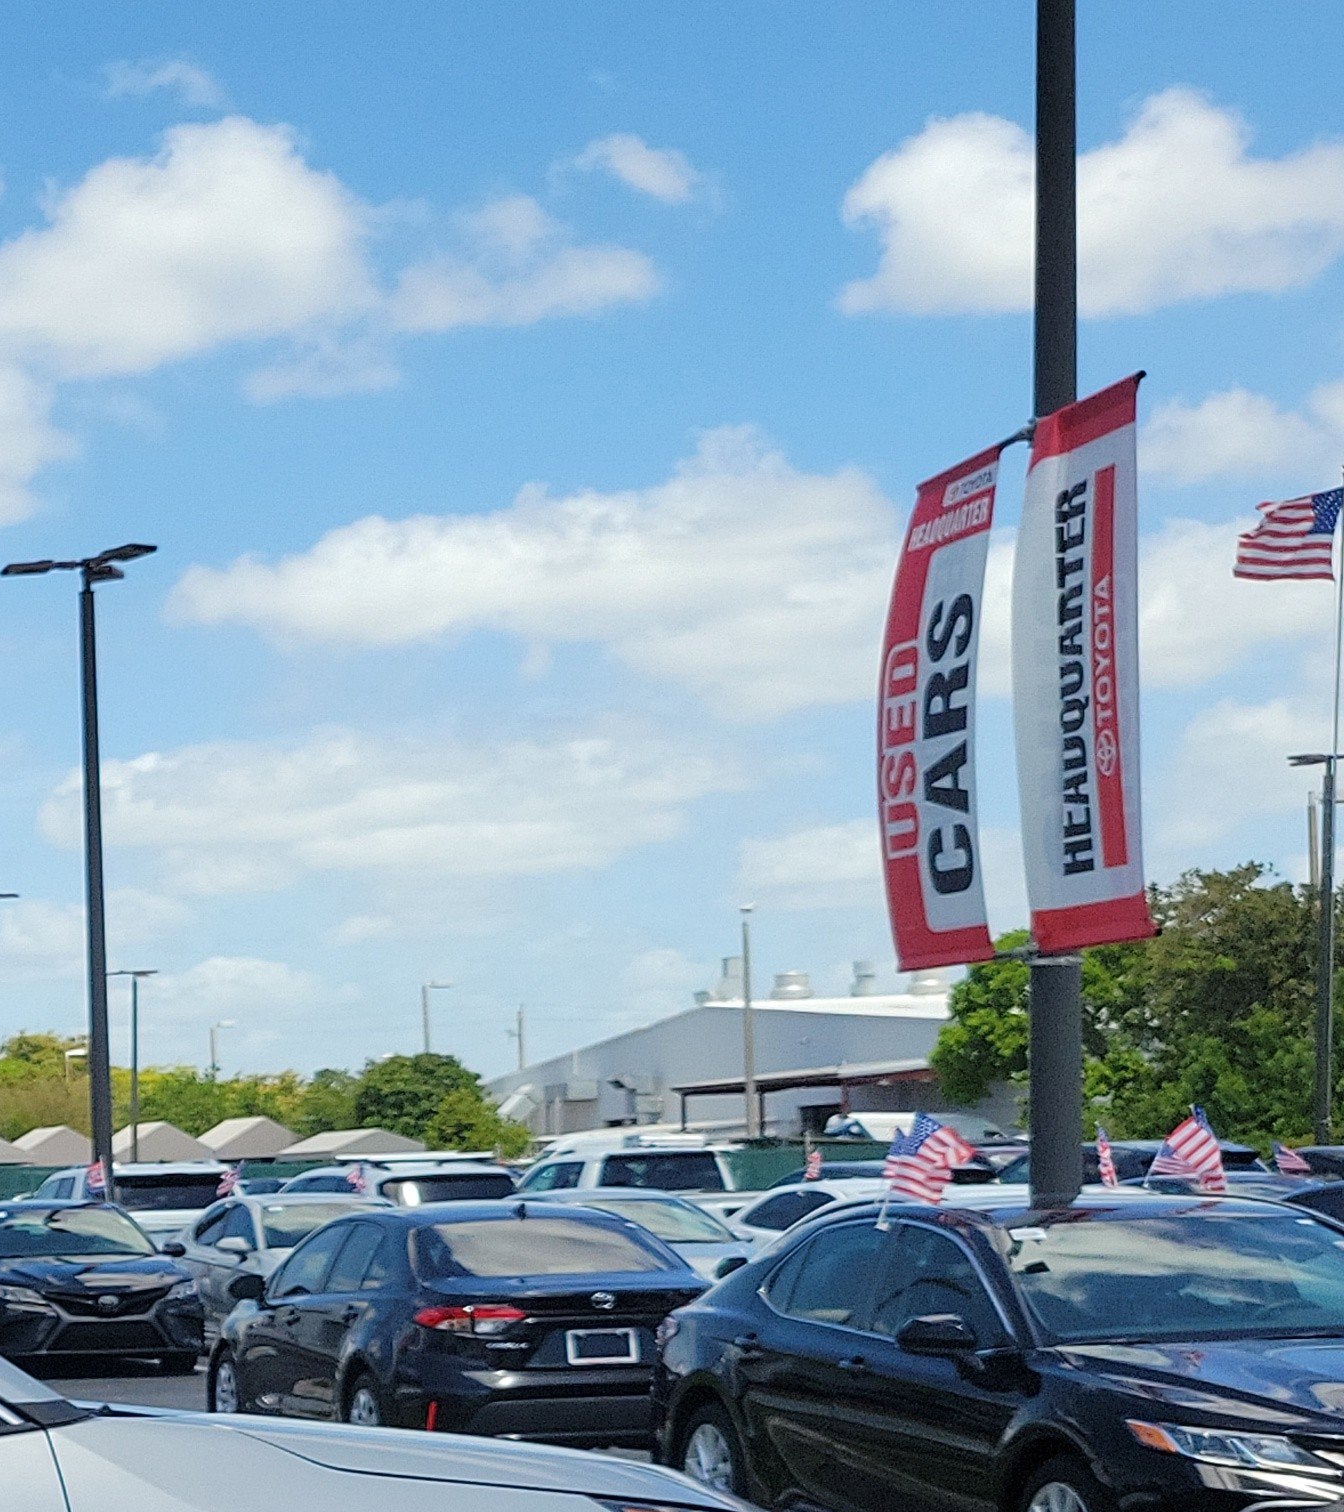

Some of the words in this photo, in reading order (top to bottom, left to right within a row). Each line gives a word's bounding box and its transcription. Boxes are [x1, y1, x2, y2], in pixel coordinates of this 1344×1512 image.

[885, 640, 921, 860] USED
[923, 593, 974, 895] CARS
[1055, 479, 1095, 876] HEADQUARTER
[1093, 574, 1114, 729] TOYOTA
